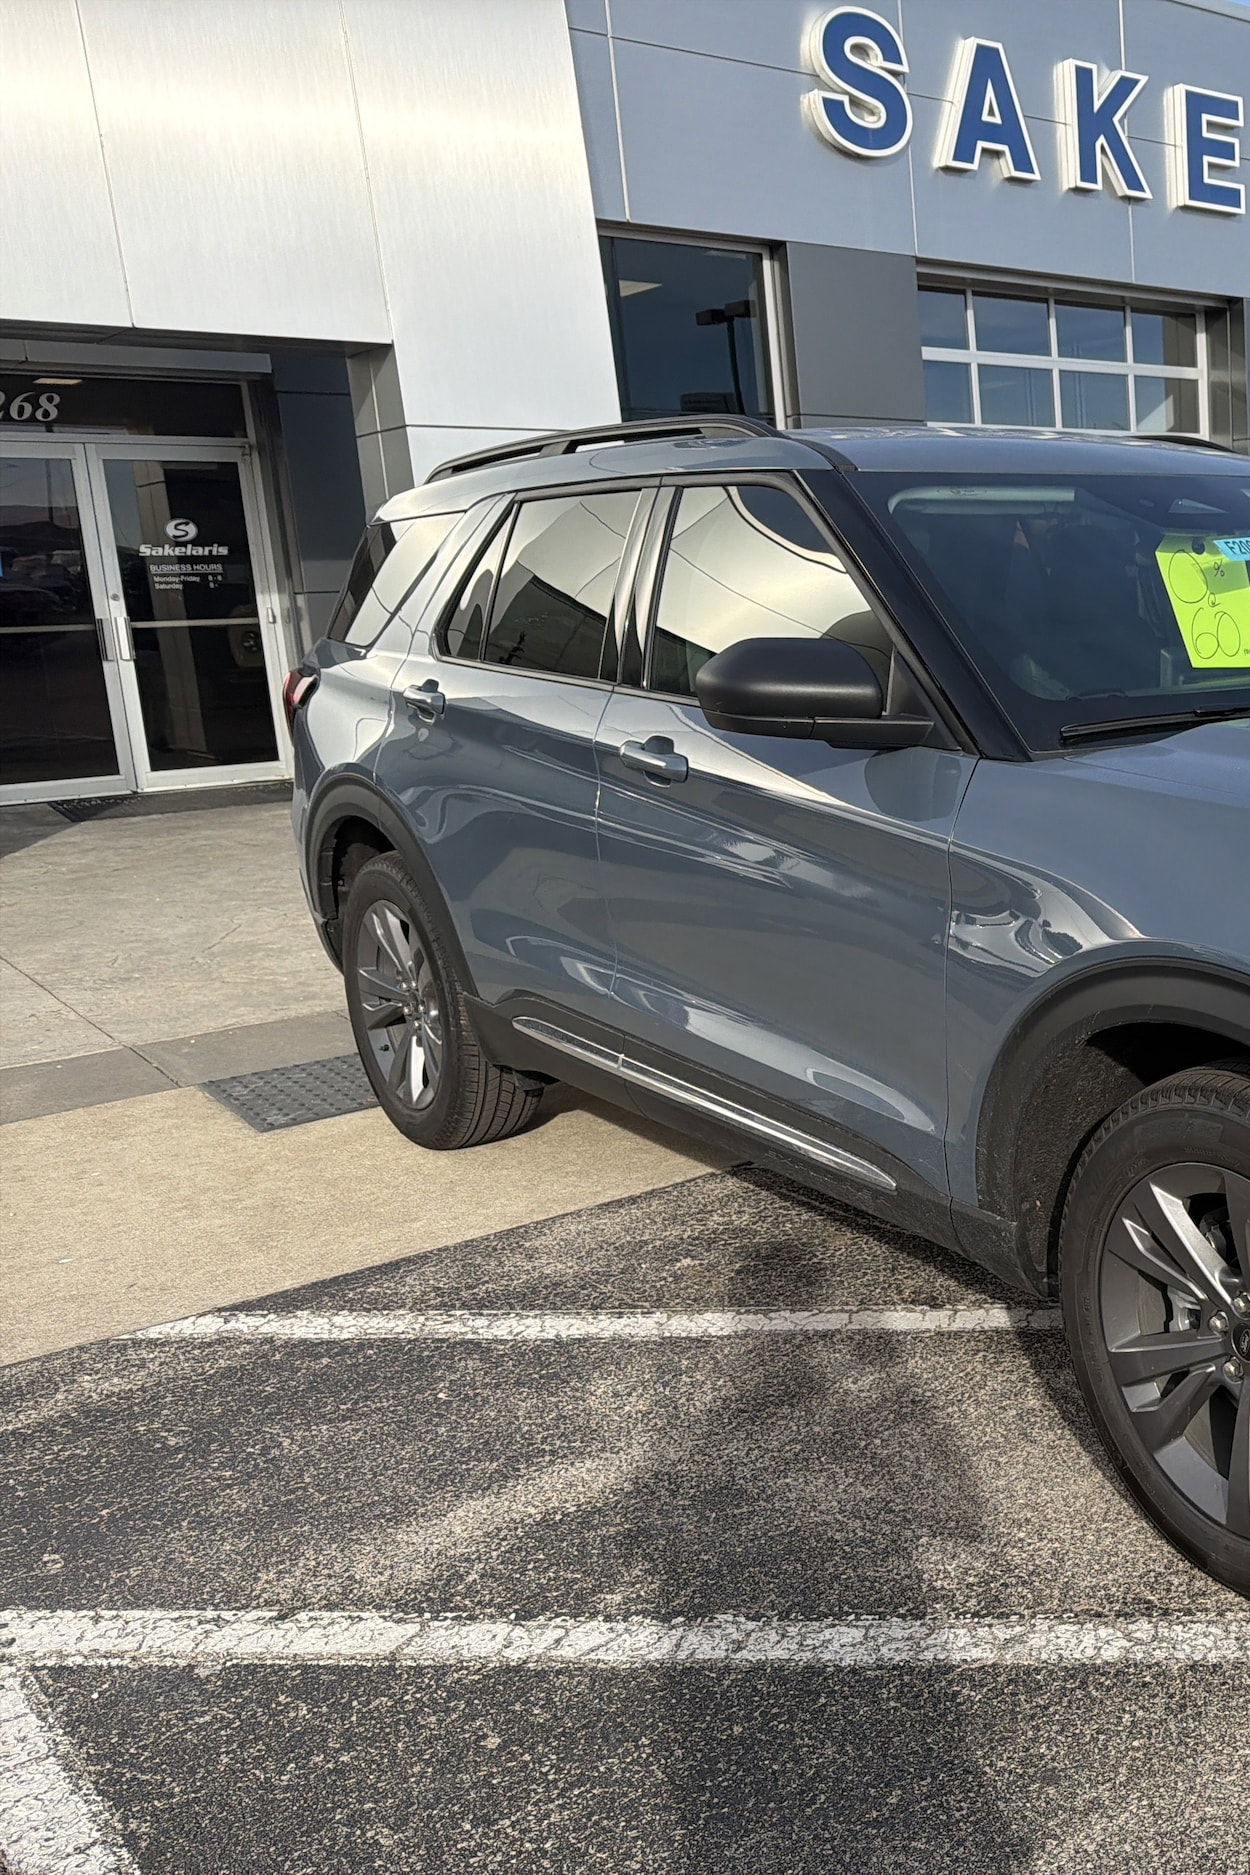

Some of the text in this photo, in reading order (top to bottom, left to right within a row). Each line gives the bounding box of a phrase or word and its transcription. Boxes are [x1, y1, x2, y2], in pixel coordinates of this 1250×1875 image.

[0, 391, 60, 421] 68
[139, 543, 229, 556] Sakelaris
[150, 563, 223, 572] BUSINESS HOURS
[1191, 607, 1241, 660] 60
